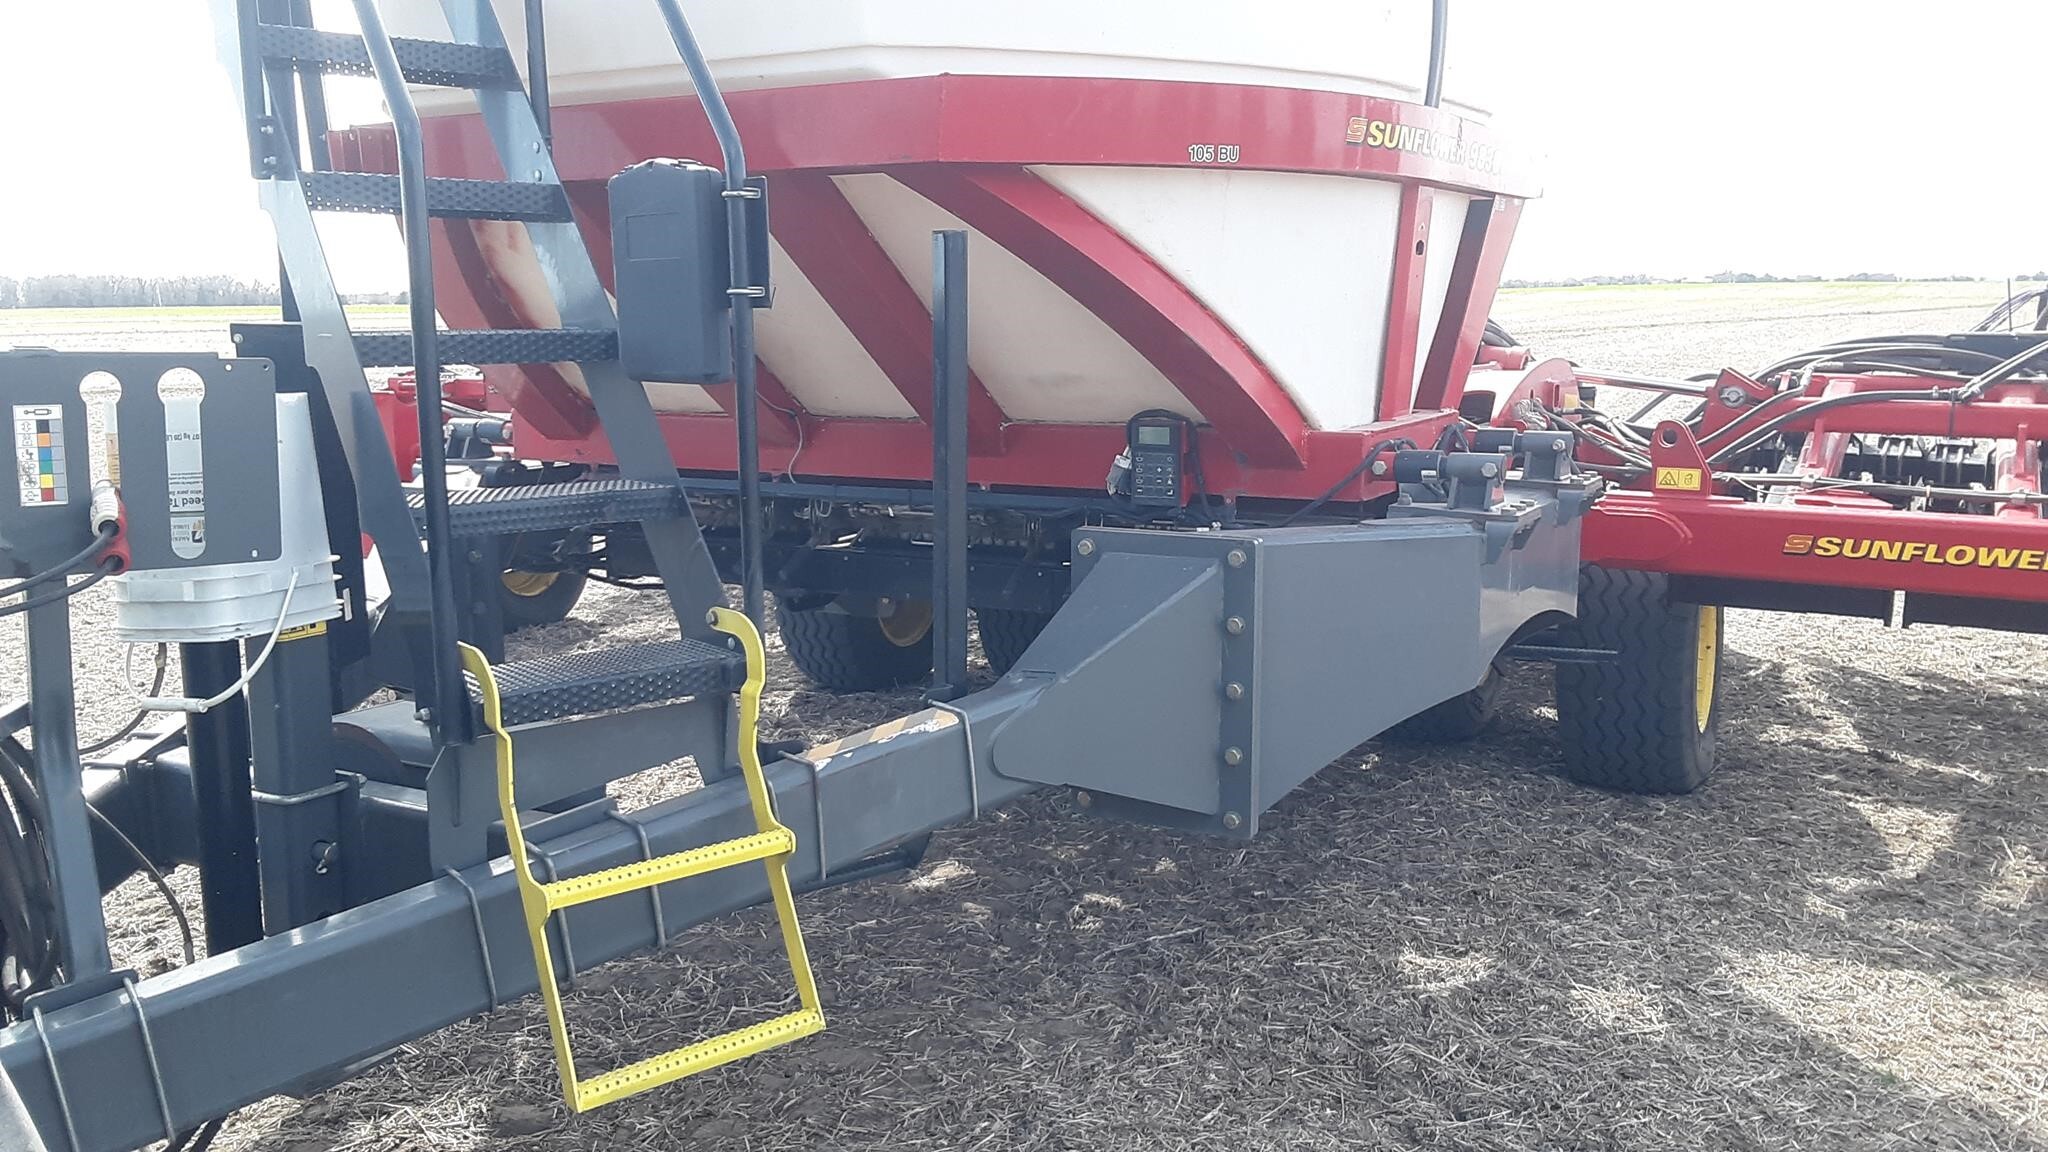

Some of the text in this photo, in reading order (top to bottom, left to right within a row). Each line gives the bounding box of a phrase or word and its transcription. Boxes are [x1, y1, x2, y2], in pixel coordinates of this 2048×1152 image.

[1188, 144, 1240, 163] 105 BU
[1366, 120, 1467, 166] SUNFLOWER
[1813, 535, 2048, 571] SUNFLOWE
